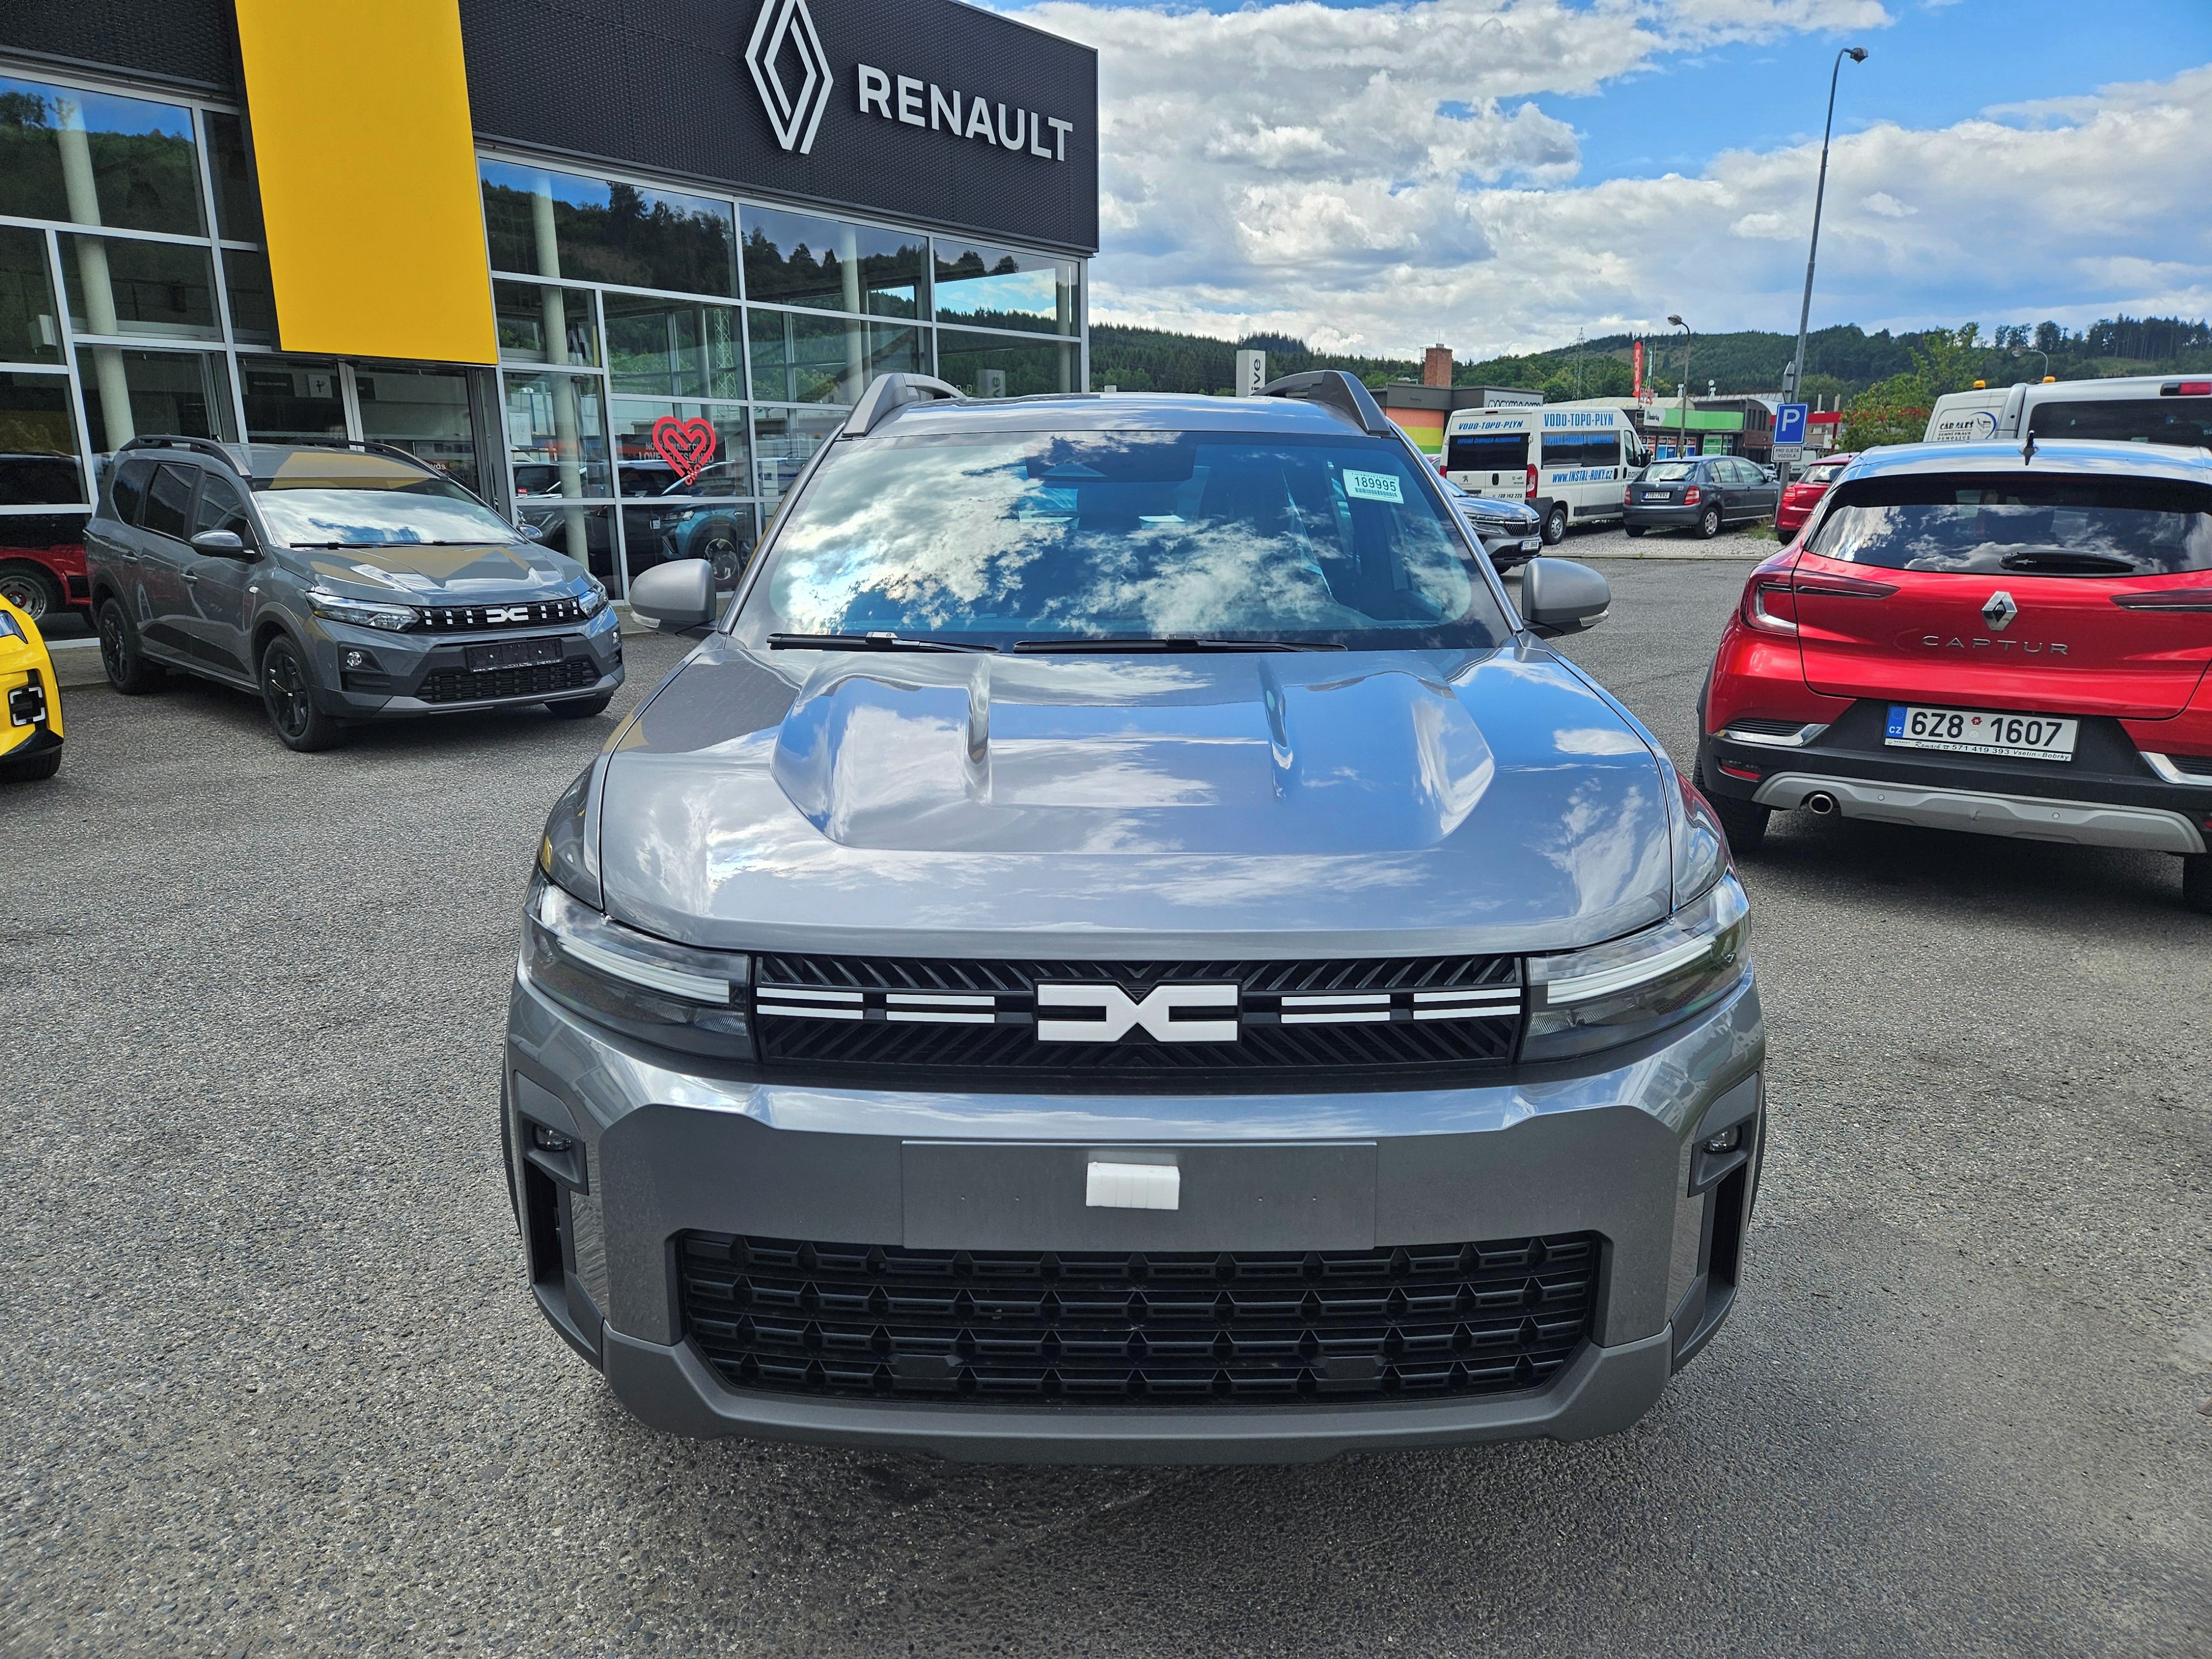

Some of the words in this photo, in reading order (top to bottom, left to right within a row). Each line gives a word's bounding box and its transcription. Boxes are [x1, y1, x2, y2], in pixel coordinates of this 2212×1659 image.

[858, 63, 1073, 161] RENAULT
[1545, 413, 1613, 426] VODO-TOPO-PLYN
[1782, 409, 1800, 431] P
[1355, 476, 1396, 492] 189995
[1922, 636, 2068, 655] CAPTUR
[1911, 712, 1964, 738] 6Z8
[1990, 717, 2062, 747] 1607
[2042, 753, 2069, 761] Bobrky
